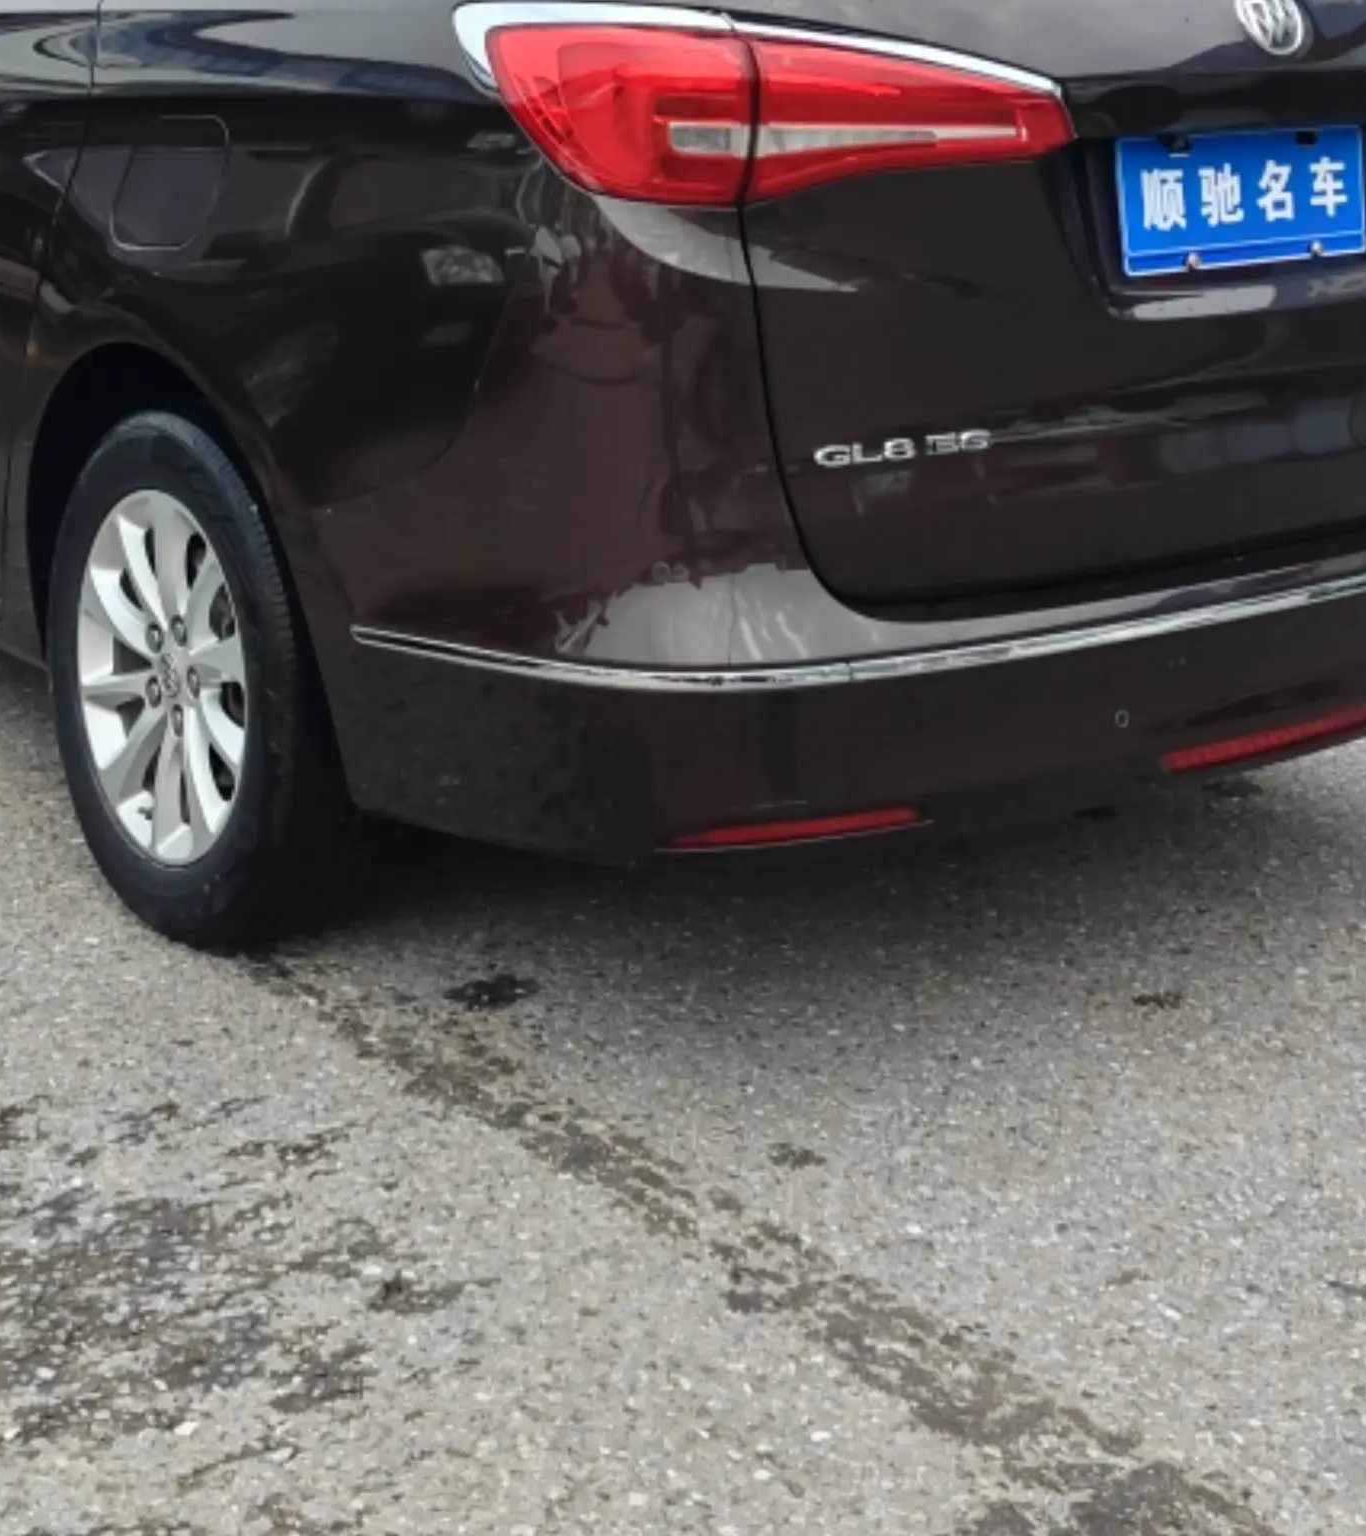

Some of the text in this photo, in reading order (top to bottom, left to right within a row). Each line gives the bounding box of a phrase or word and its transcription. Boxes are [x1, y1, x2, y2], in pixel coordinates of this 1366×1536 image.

[1140, 156, 1348, 231] 顺驰名车
[813, 436, 916, 469] GL8
